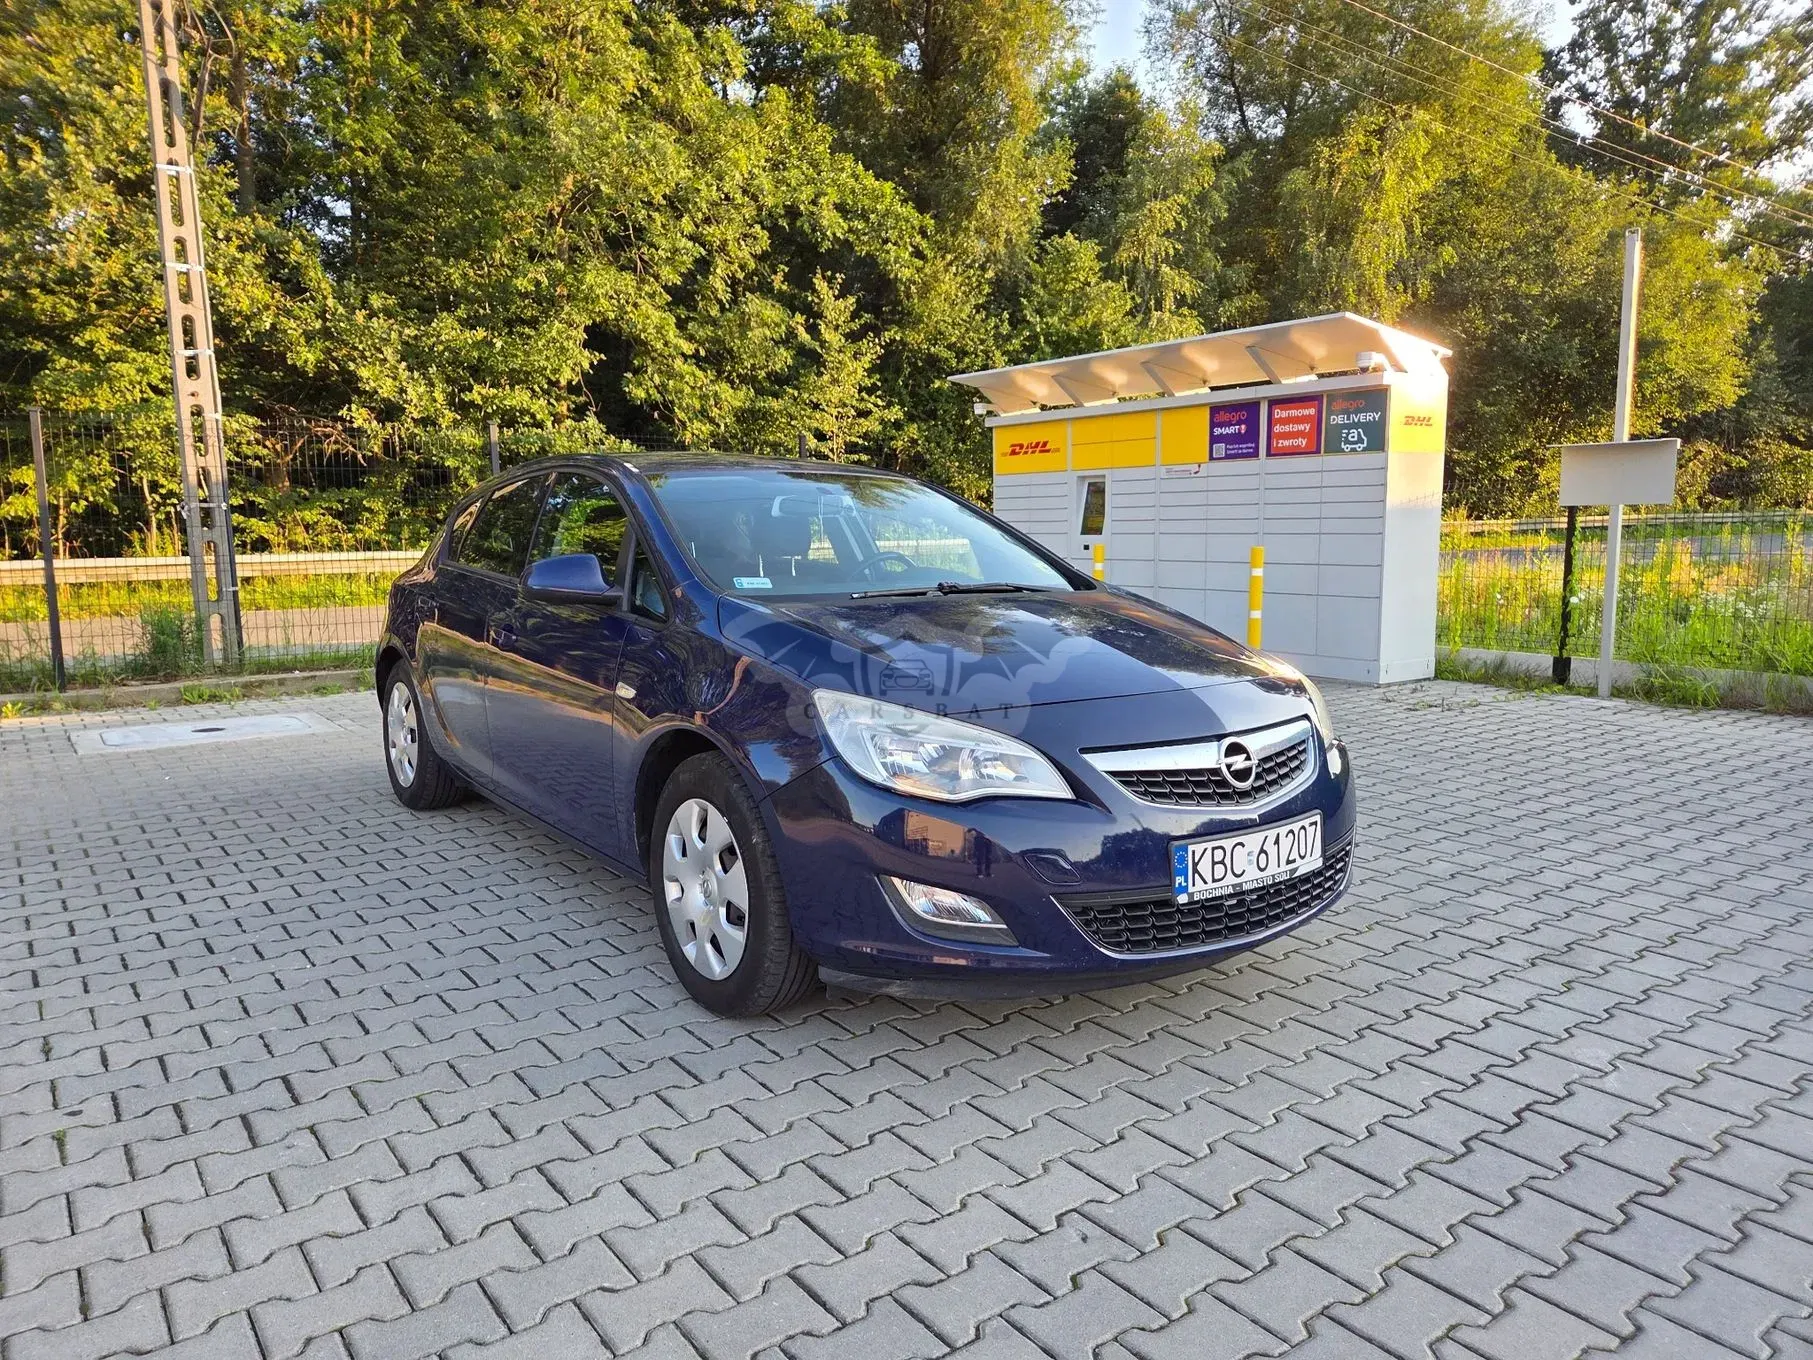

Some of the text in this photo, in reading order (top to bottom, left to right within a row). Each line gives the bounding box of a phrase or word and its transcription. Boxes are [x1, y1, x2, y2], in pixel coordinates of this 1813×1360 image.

[1331, 400, 1365, 411] allegro
[1214, 411, 1247, 424] allegro
[1274, 407, 1316, 418] Darmowe
[1330, 412, 1381, 424] DELIVERY
[1403, 415, 1433, 427] DHL
[1273, 422, 1311, 433] dostawy
[1009, 440, 1051, 456] DHL
[1278, 438, 1307, 448] zwroty
[1191, 820, 1318, 888] KBC 61207
[1175, 876, 1188, 888] PL
[1193, 886, 1234, 901] BOCHNIA
[1242, 876, 1273, 891] MIASTO
[1274, 871, 1291, 884] SOLI
